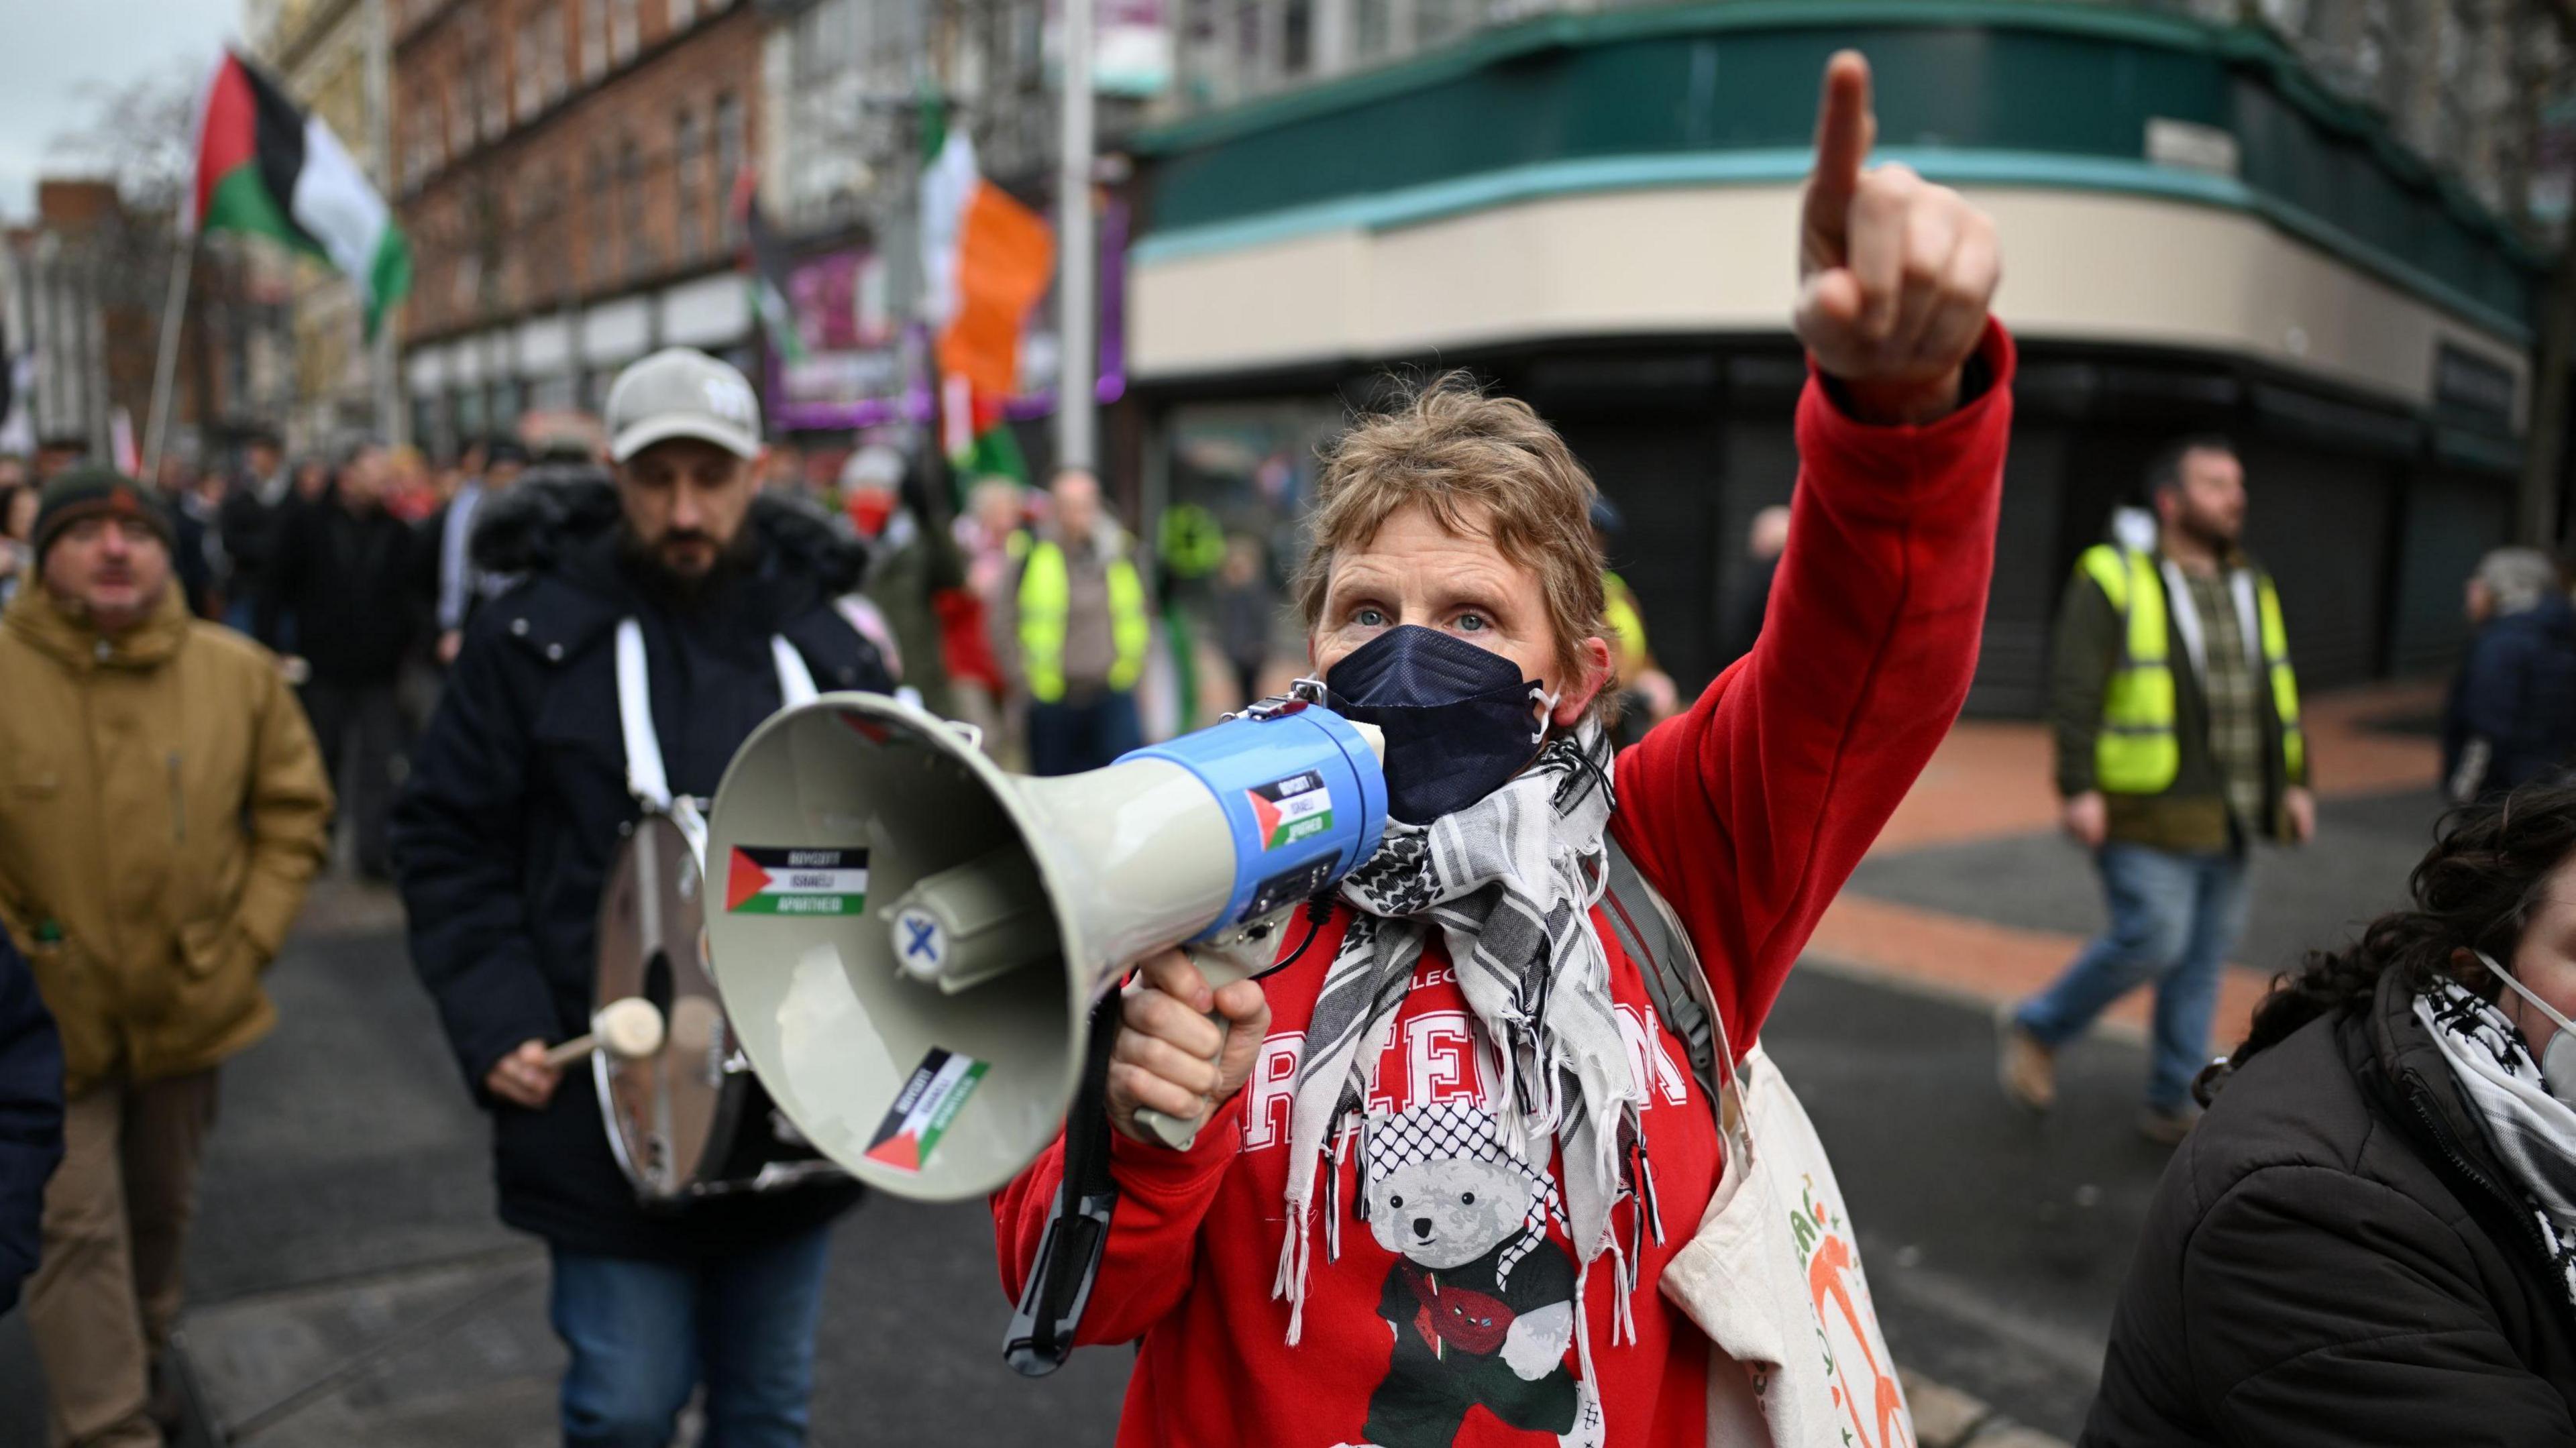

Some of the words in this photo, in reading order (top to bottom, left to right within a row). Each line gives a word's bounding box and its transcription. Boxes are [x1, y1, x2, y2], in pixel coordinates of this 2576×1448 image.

[787, 850, 841, 866] BOYCOTT
[790, 874, 835, 888] ISRAELI
[777, 896, 843, 912] APARTHEID
[894, 1068, 934, 1114] BOYCOTT
